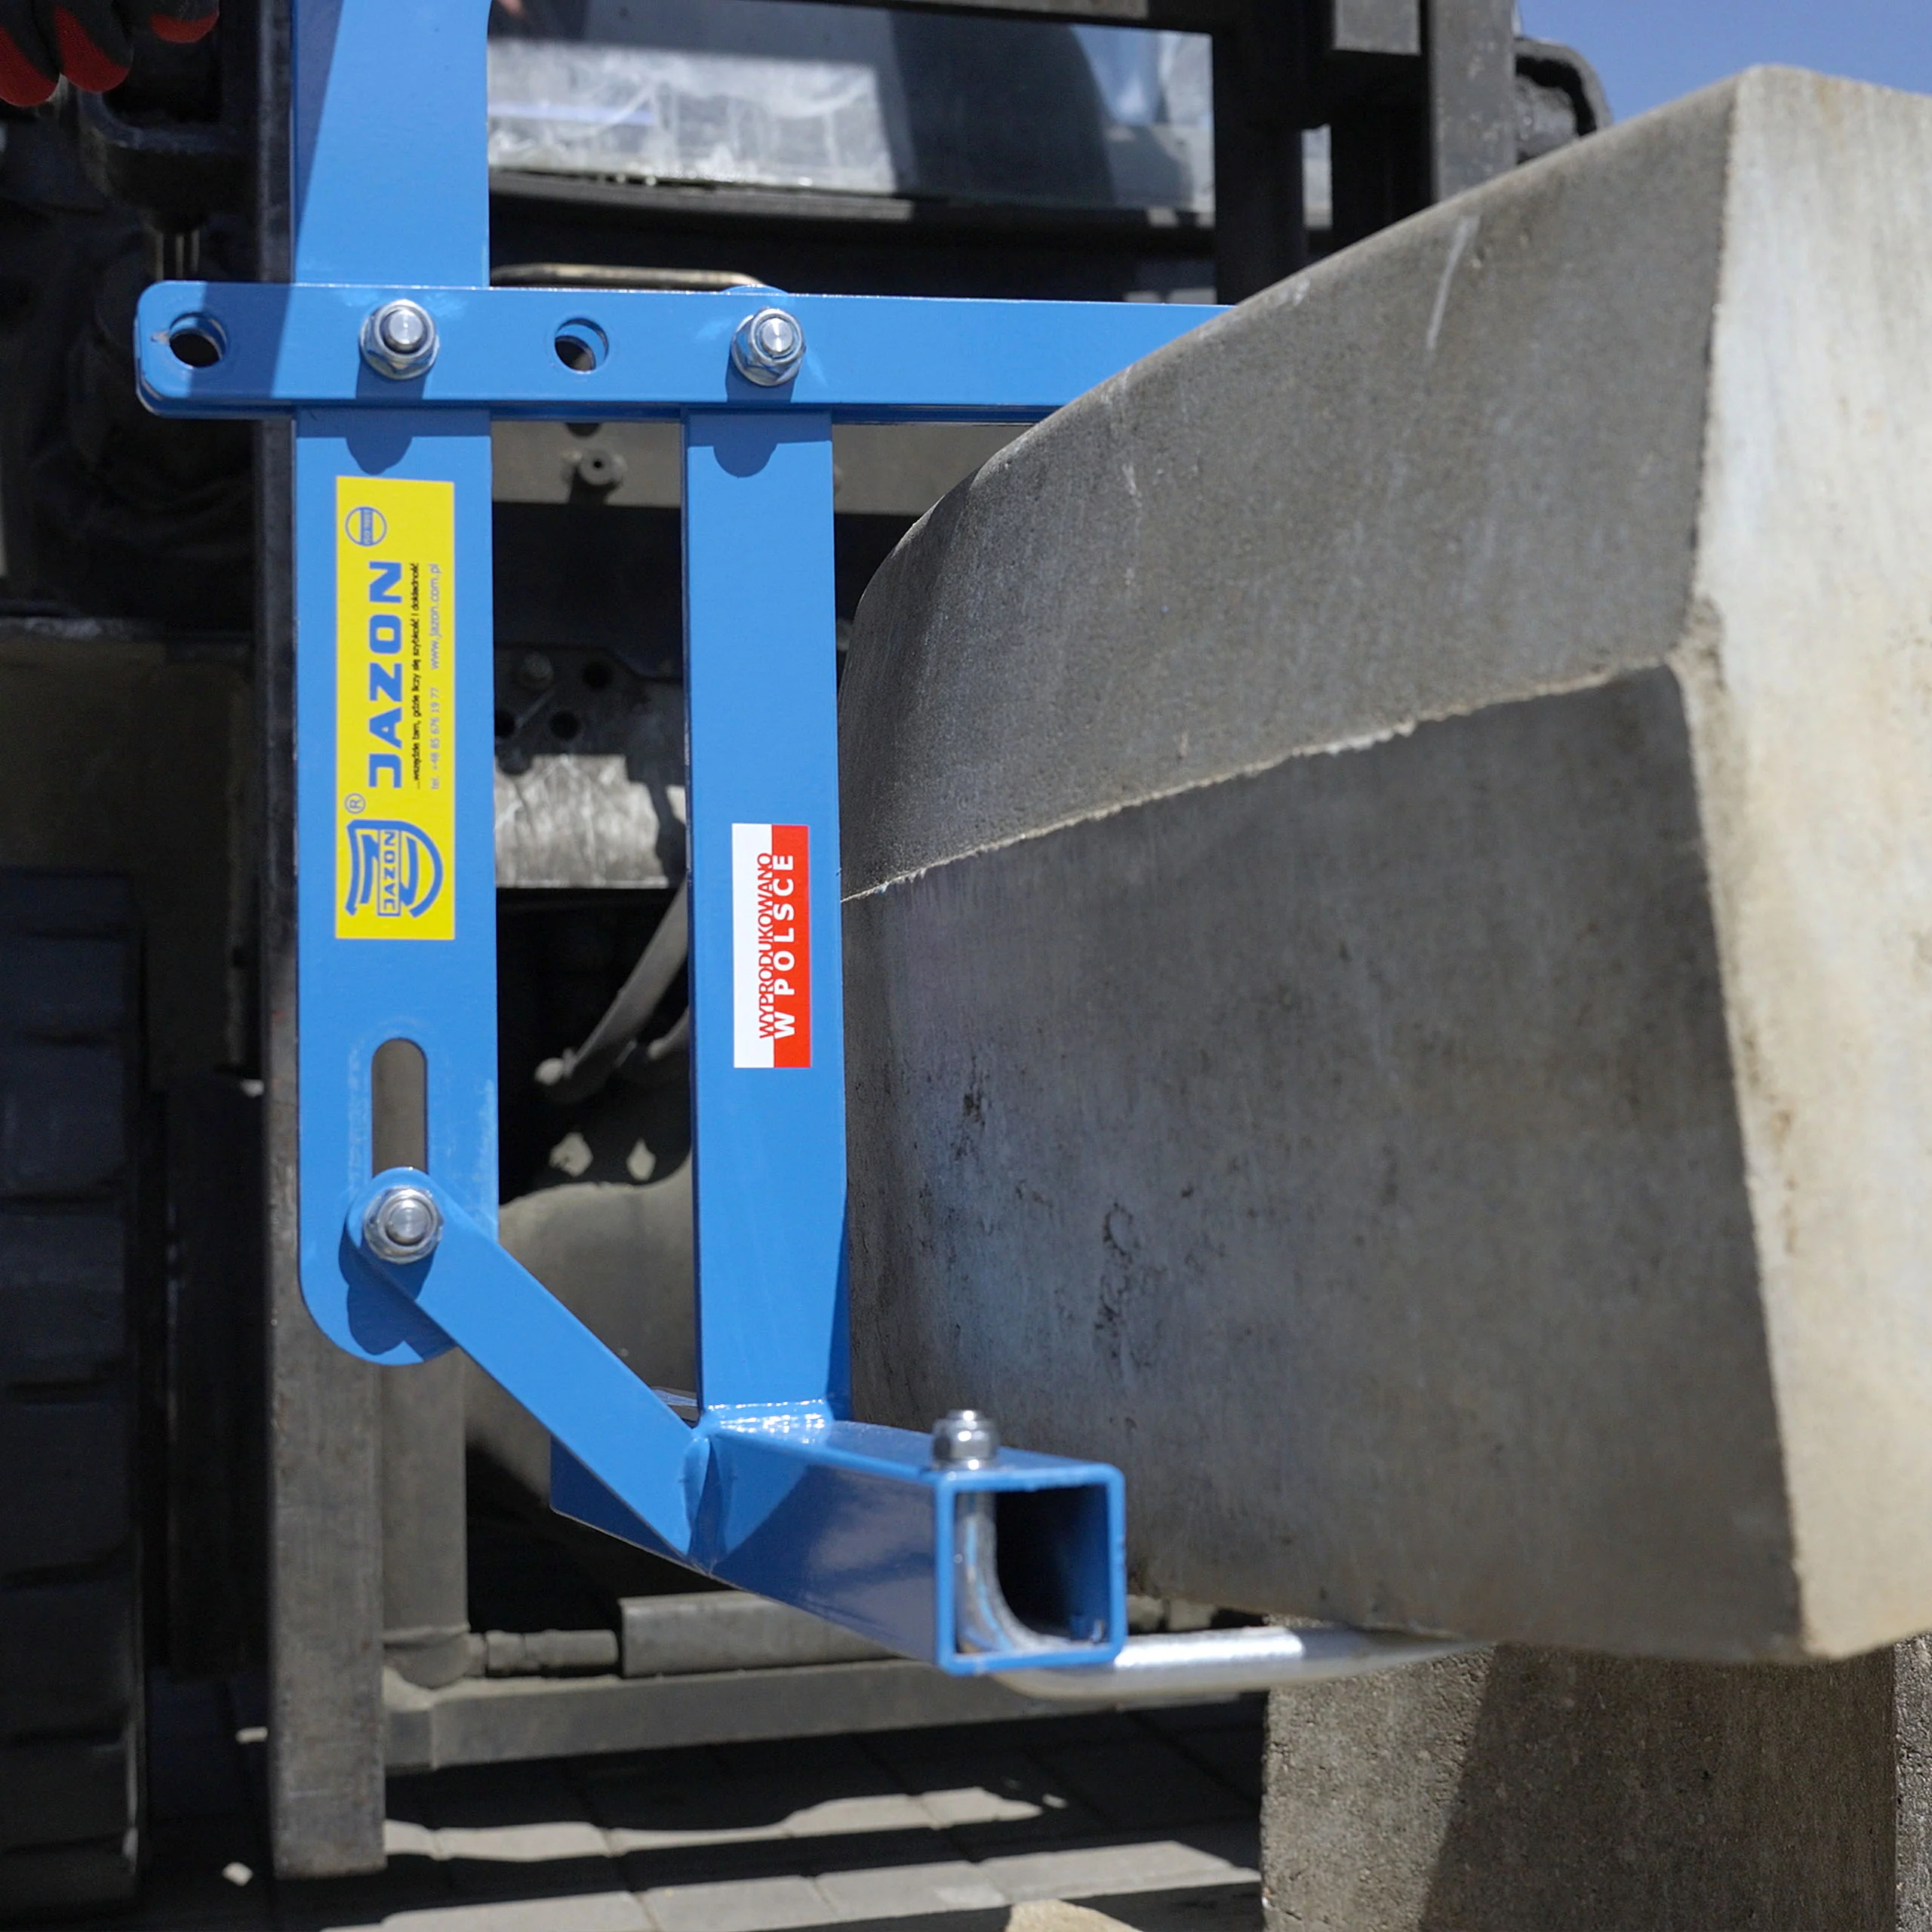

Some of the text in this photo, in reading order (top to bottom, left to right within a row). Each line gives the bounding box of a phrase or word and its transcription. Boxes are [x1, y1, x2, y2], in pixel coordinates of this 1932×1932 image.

[410, 563, 420, 611] dokładność
[427, 563, 441, 670] www.jazon.com.pl
[368, 561, 403, 789] JAZON
[411, 673, 422, 691] liczy
[412, 695, 422, 717] gdzie
[429, 687, 439, 699] 77
[429, 702, 439, 712] 19
[429, 737, 439, 749] 85
[429, 752, 439, 770] +48
[383, 830, 396, 911] JAZON
[757, 853, 774, 1038] WYPRODUKOWANO
[772, 855, 795, 1039] W POLSCE
